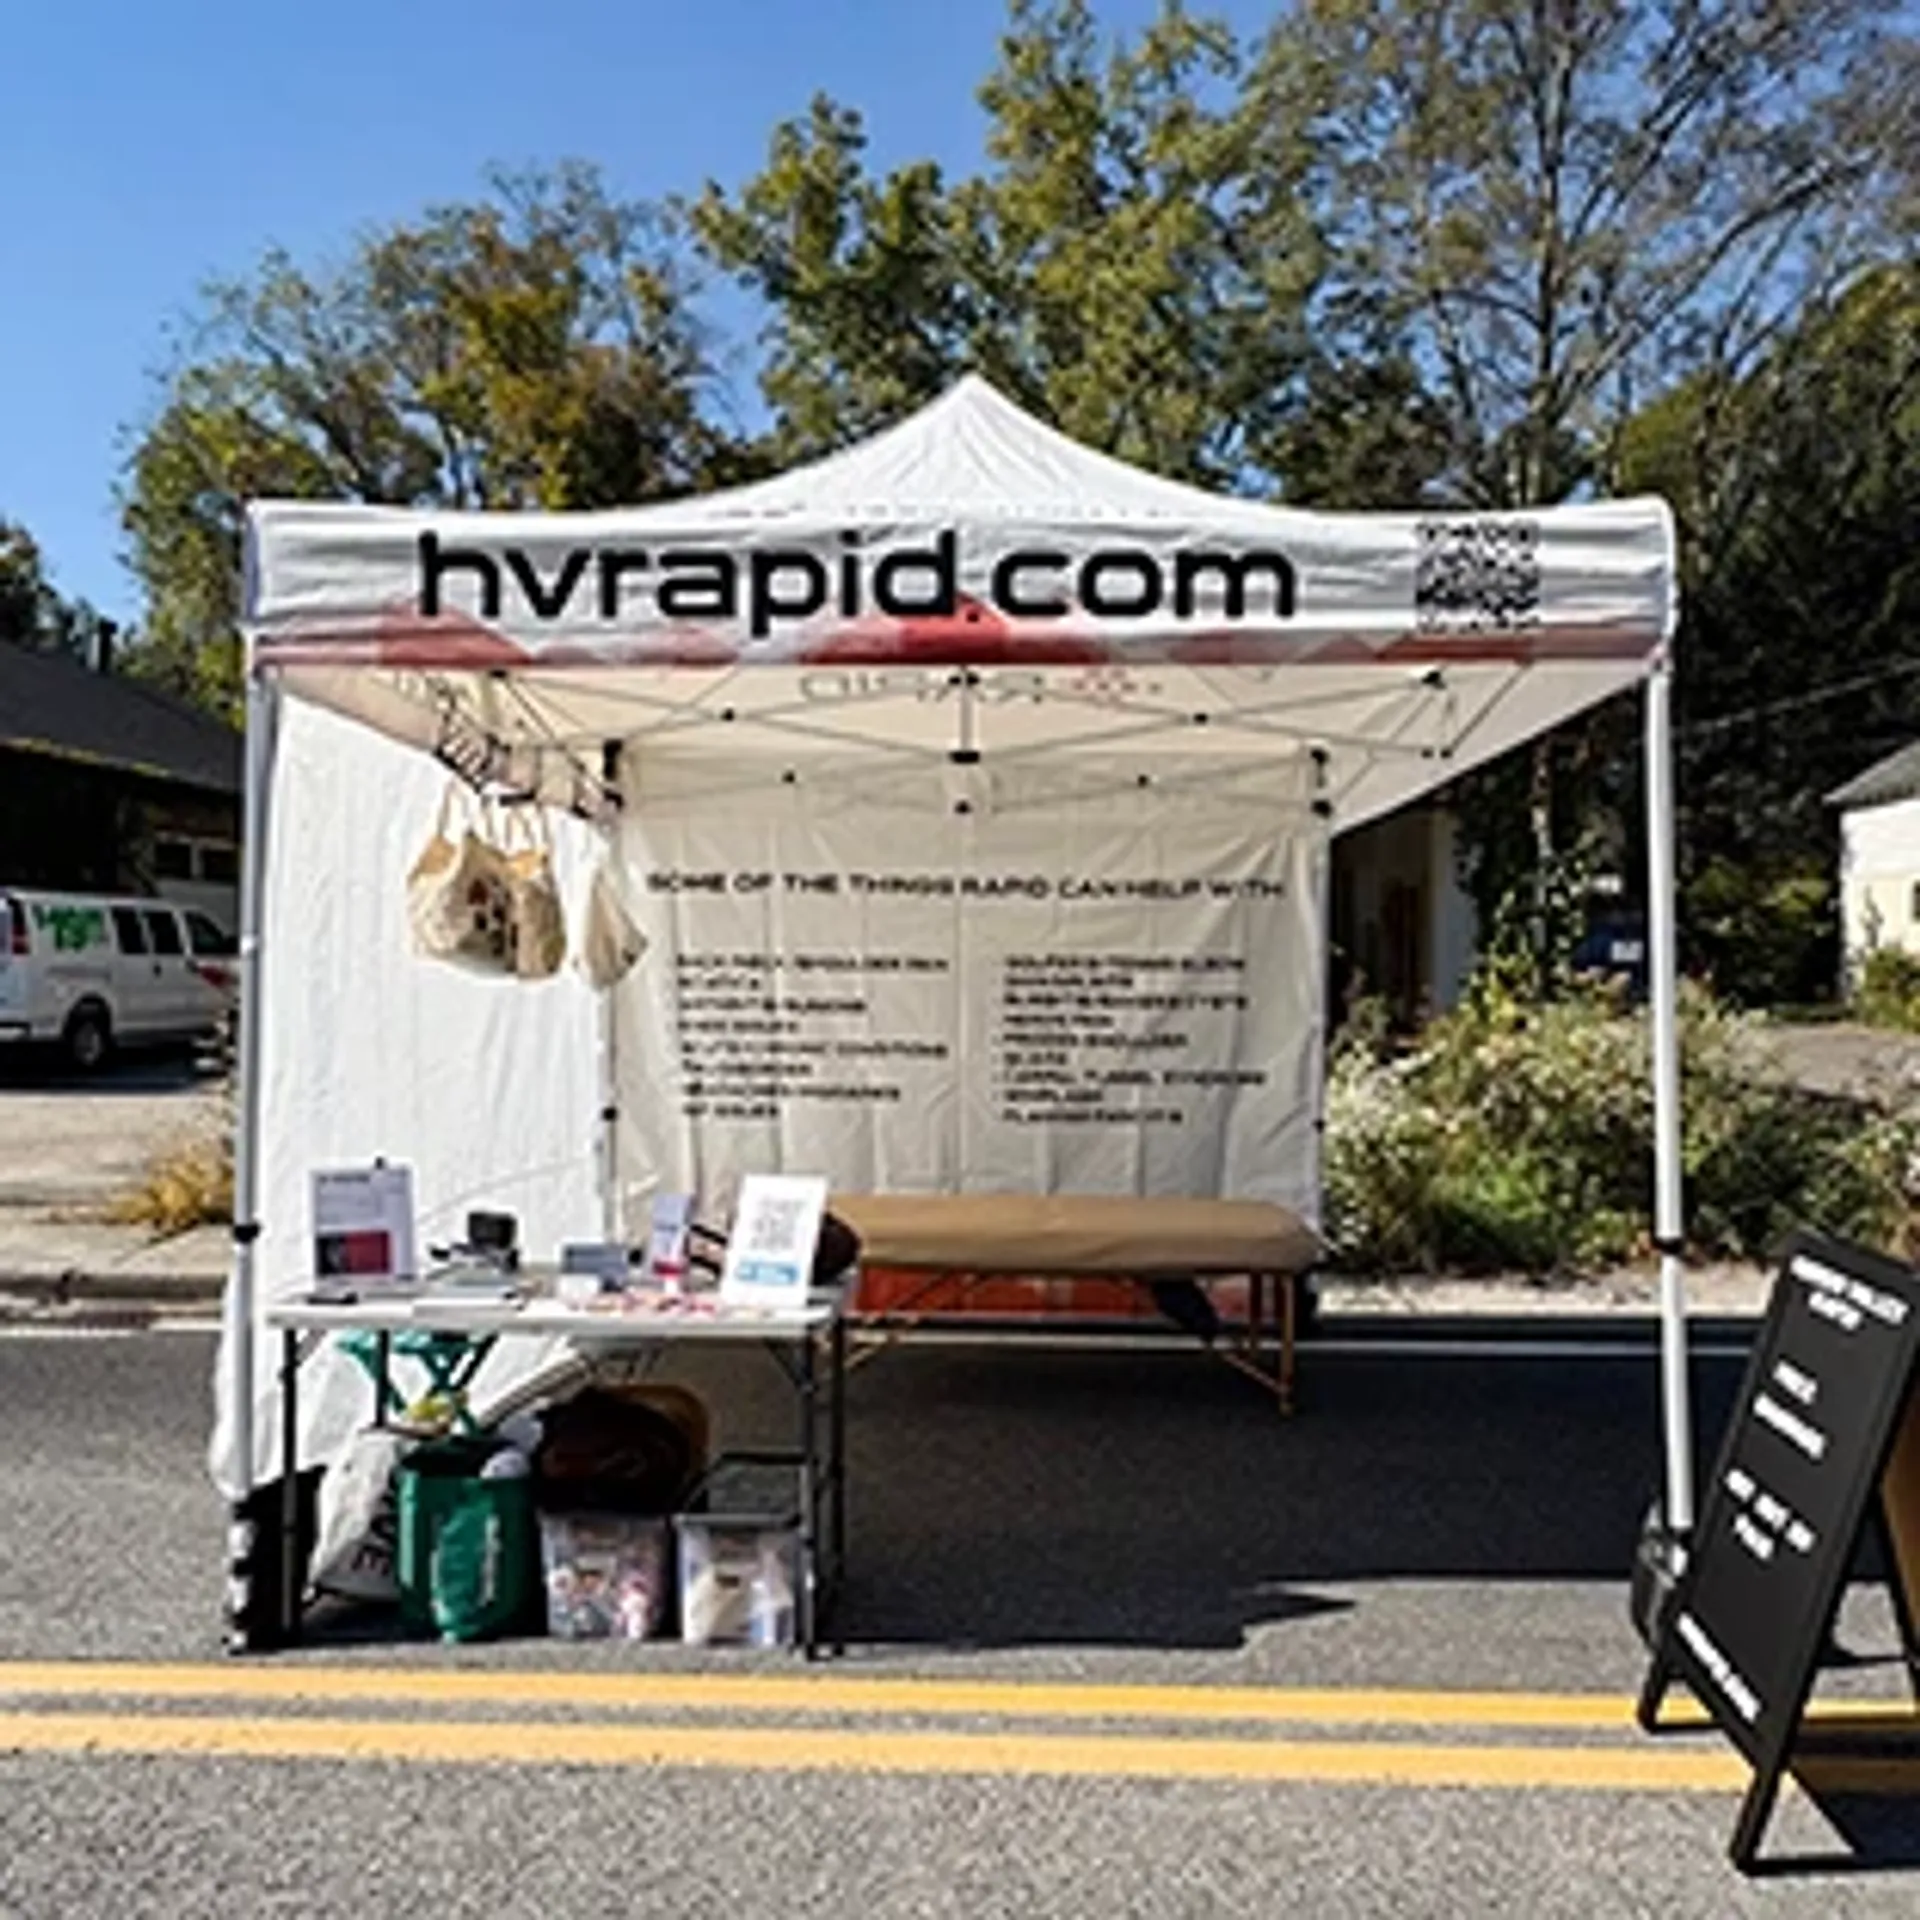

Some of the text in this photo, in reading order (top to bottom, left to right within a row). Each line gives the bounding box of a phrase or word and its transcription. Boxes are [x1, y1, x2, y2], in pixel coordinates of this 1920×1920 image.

[418, 529, 1296, 636] hvrapid.com
[648, 873, 1285, 899] SOME OF THE THINGS RAPID CAN HELP WITH
